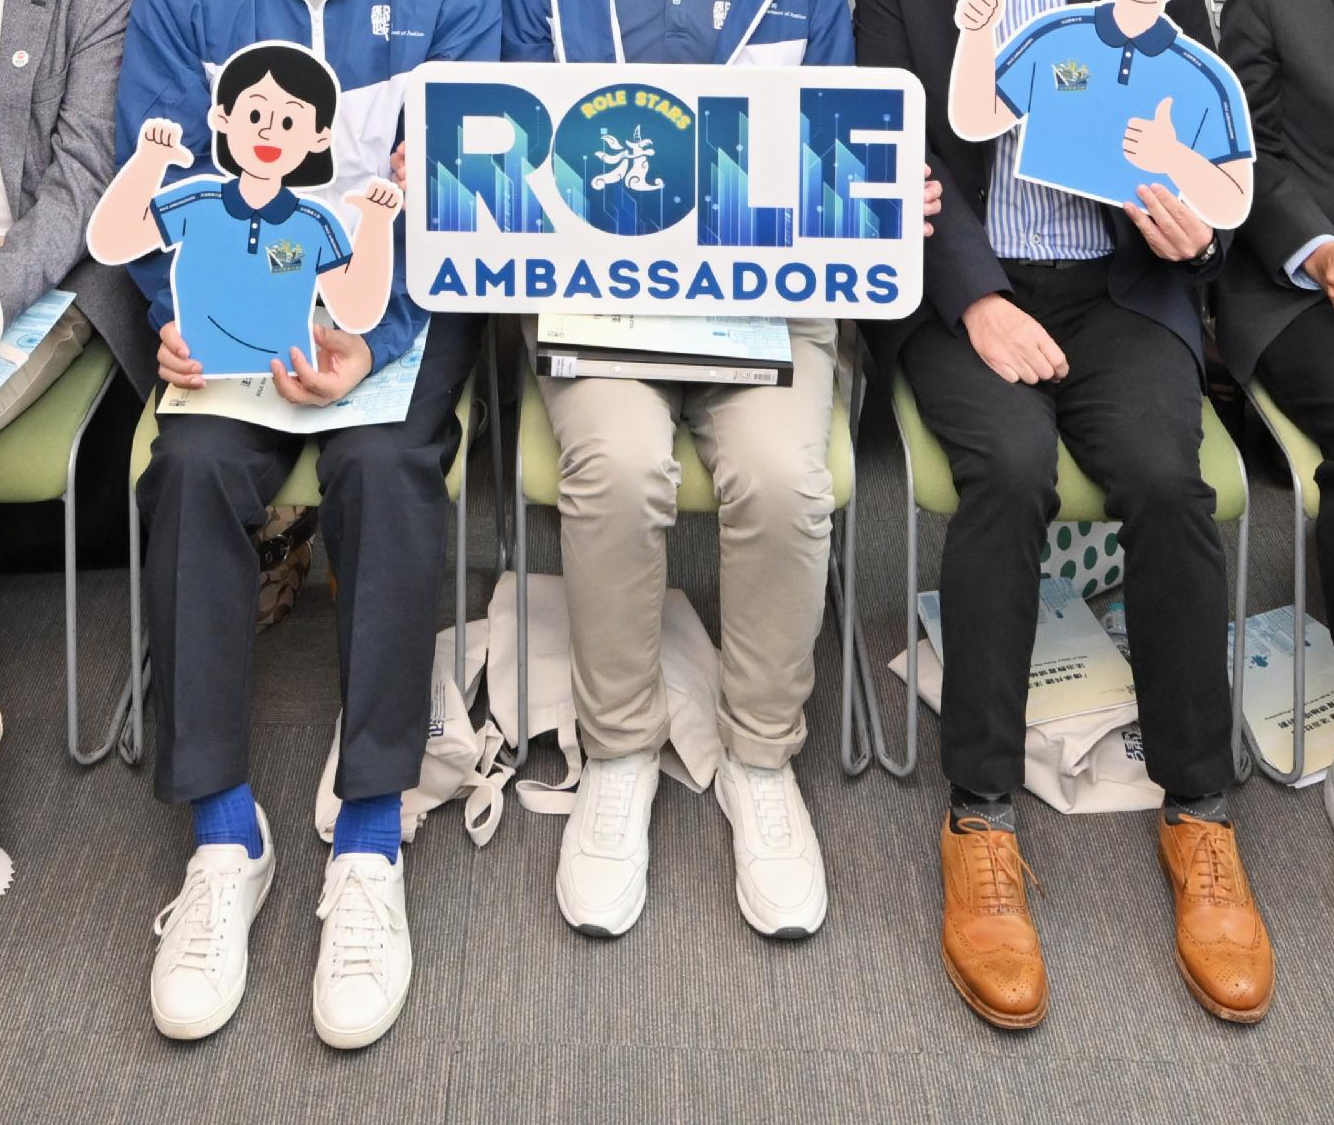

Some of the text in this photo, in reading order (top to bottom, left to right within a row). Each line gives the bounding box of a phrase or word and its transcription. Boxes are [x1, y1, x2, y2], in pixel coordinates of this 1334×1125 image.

[581, 90, 692, 129] ROLE STARS
[425, 82, 905, 247] ROLE
[429, 257, 900, 305] AMBASSADORS
